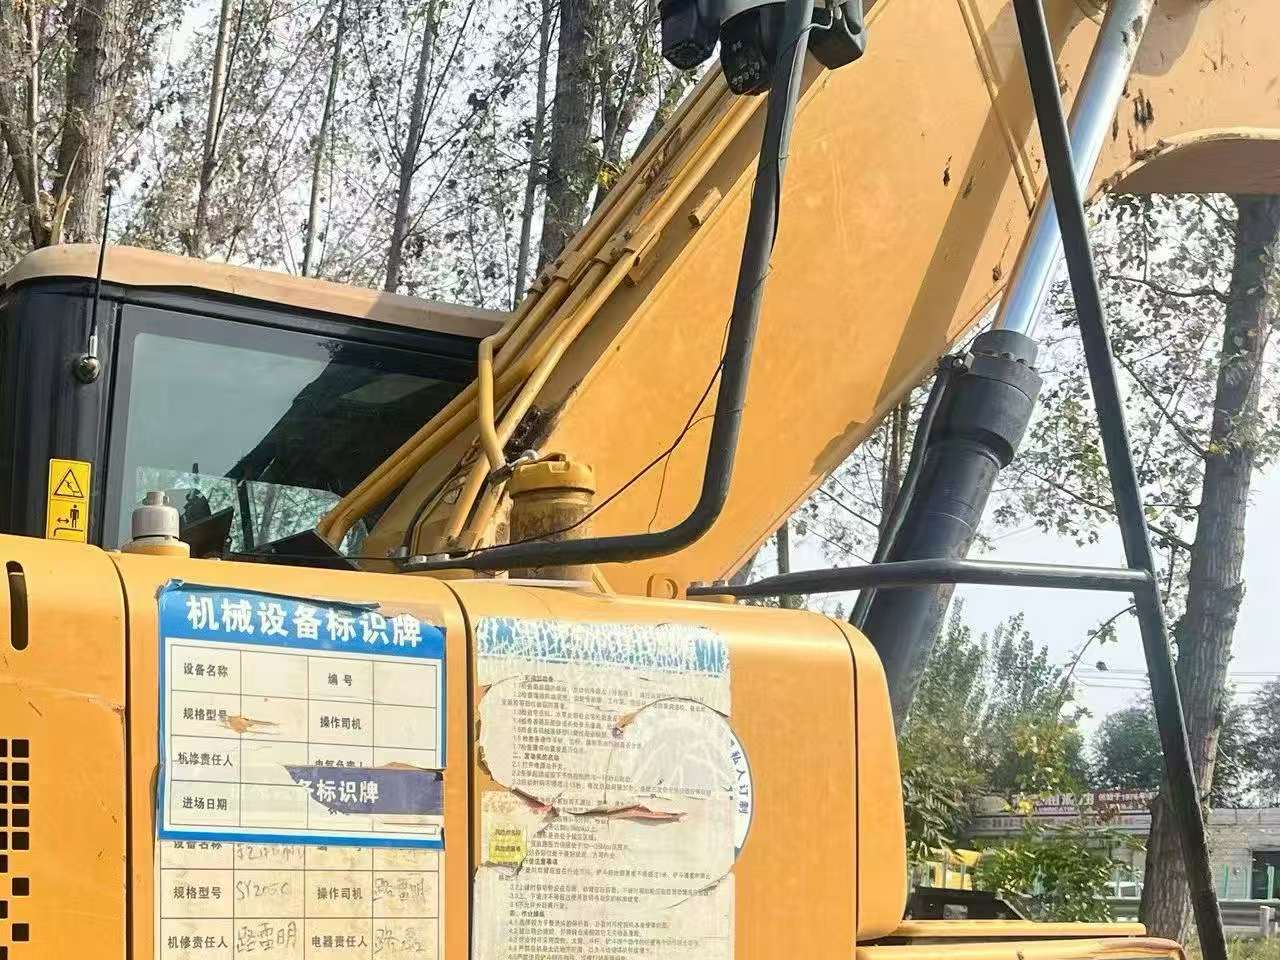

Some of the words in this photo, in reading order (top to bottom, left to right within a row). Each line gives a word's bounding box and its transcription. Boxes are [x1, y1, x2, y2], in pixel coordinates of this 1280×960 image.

[186, 594, 423, 648] 机械设备标识牌
[183, 662, 229, 678] 设备名称
[183, 707, 228, 722] 规格型号
[319, 715, 362, 731] 操作司机
[177, 751, 234, 768] 机修责任人
[182, 796, 228, 812] 进场日期
[173, 885, 222, 900] 规格型号
[317, 886, 363, 901] 操作司机
[167, 935, 229, 949] 机修责任人
[311, 935, 368, 949] 电器责任人
